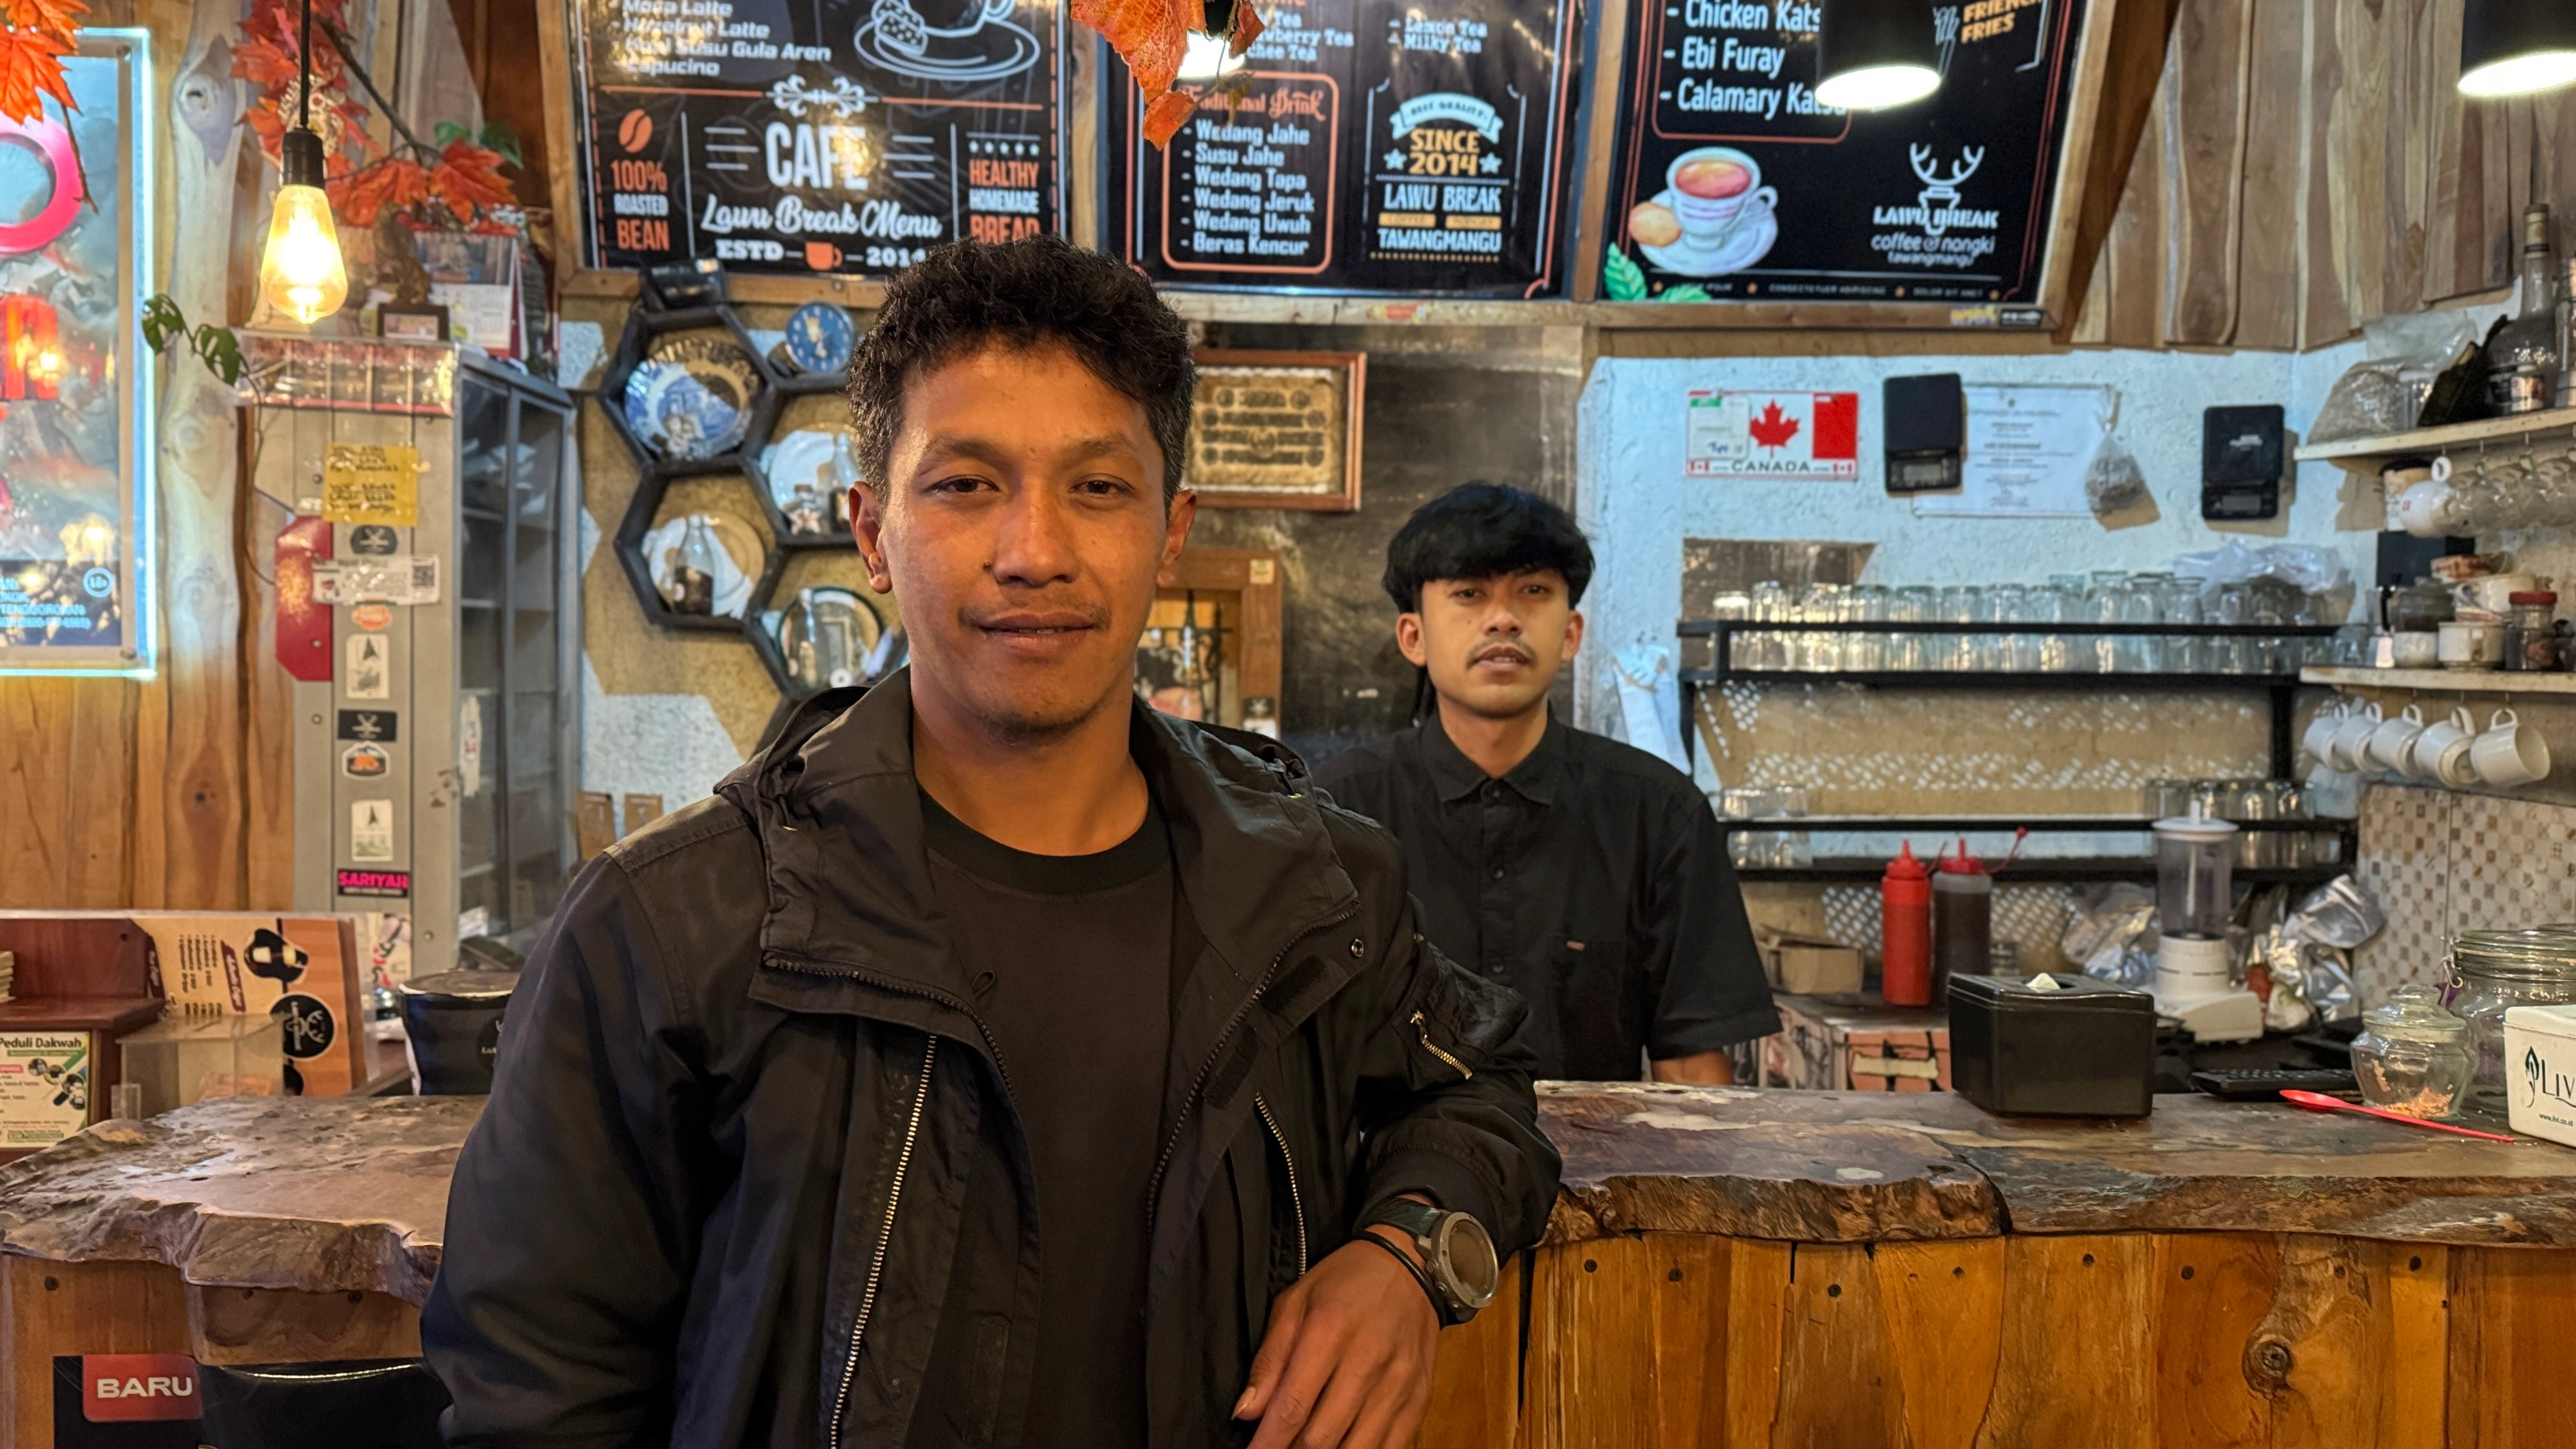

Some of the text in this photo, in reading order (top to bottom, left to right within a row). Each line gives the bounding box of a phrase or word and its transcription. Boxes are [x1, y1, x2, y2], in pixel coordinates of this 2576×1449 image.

[681, 0, 733, 17] Latte
[1273, 10, 1303, 29] Tea
[1685, 0, 1821, 32] Chicken Kats
[718, 20, 770, 39] Latte
[1324, 27, 1355, 48] Tea
[1404, 16, 1488, 38] Lemon Tea
[1961, 12, 2016, 45] FRIES
[732, 41, 778, 59] Gula
[781, 43, 832, 61] Aren
[1246, 42, 1318, 62] chee Tea
[1404, 33, 1482, 54] Milky Tea
[1682, 36, 1786, 80] Ebi Furay
[1269, 87, 1326, 122] Drink
[1677, 77, 1781, 121] Calamary
[1195, 118, 1310, 146] Wedang Jahe
[1409, 128, 1481, 153] SINCE
[1195, 141, 1285, 167] Susu Jahe
[1409, 152, 1478, 176] 2014
[611, 160, 668, 192] 100%
[969, 160, 1039, 188] HEALTHY
[1194, 164, 1262, 192] Wedang
[613, 194, 669, 216] ROASTED
[969, 188, 1039, 213] HOMEMADE
[1194, 187, 1315, 215] Wedang Jeruk
[1384, 183, 1501, 213] LAWU BREAK
[700, 193, 944, 241] Lawu Break Menu
[1193, 209, 1312, 236] Wedang Uwuh
[1873, 205, 2000, 229] LAWU BREAK
[617, 219, 670, 251] BEAN
[970, 215, 1041, 245] BREAD
[1377, 227, 1501, 253] TAWANGMANGU
[716, 239, 785, 261] ESTD
[1193, 231, 1309, 256] Beras Kencur
[1871, 232, 1922, 252] coffee
[1941, 234, 1996, 257] nongki
[1731, 459, 1811, 473] CANADA
[338, 871, 409, 889] SARIYAH
[35, 1037, 82, 1048] Dakwah
[97, 1376, 193, 1399] BARU
